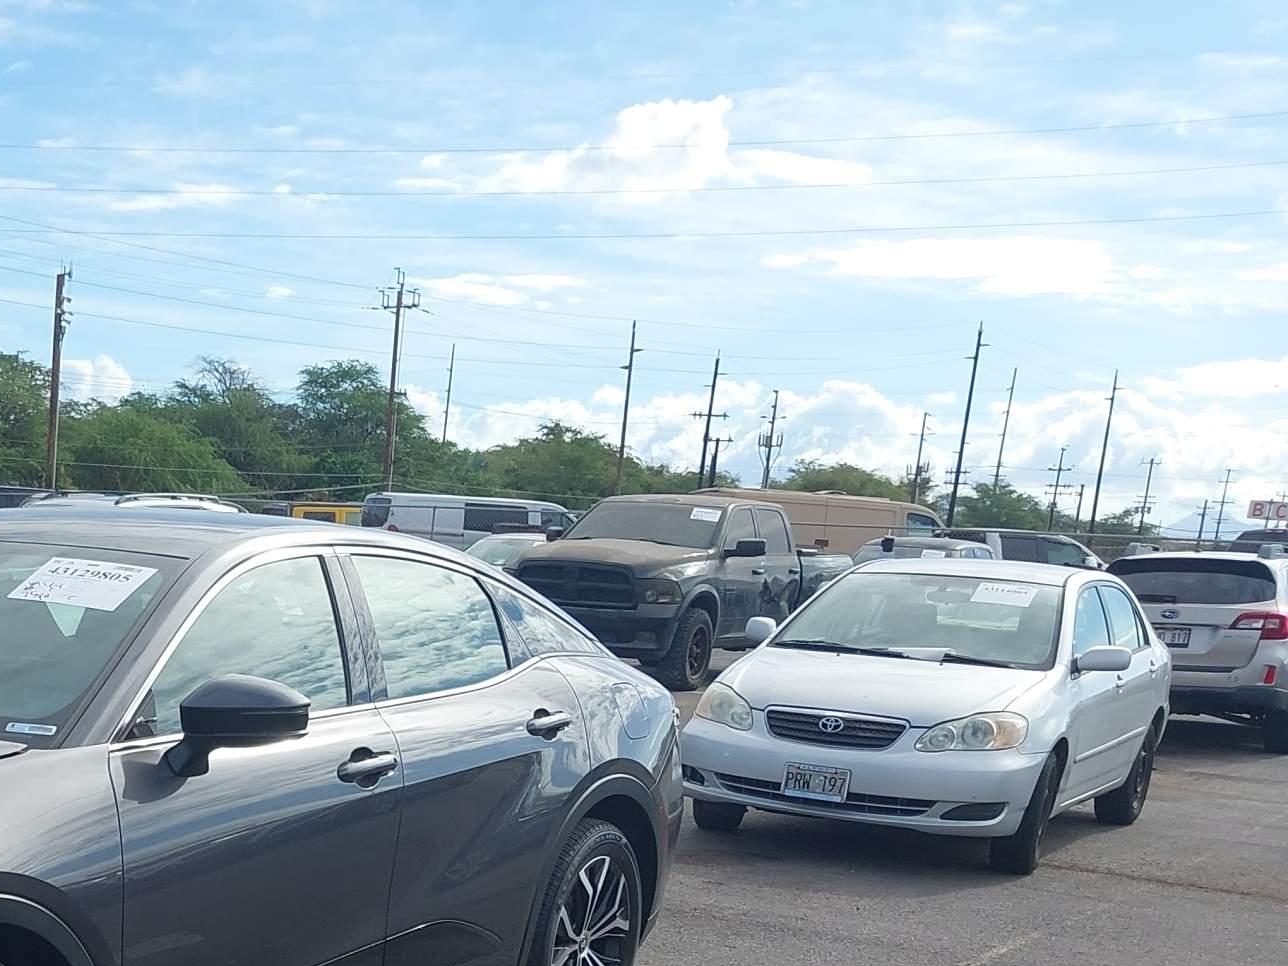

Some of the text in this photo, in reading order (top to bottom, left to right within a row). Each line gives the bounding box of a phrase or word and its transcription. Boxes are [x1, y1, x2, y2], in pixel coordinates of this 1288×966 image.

[48, 566, 133, 583] 43129805
[785, 771, 846, 794] PRW 197
